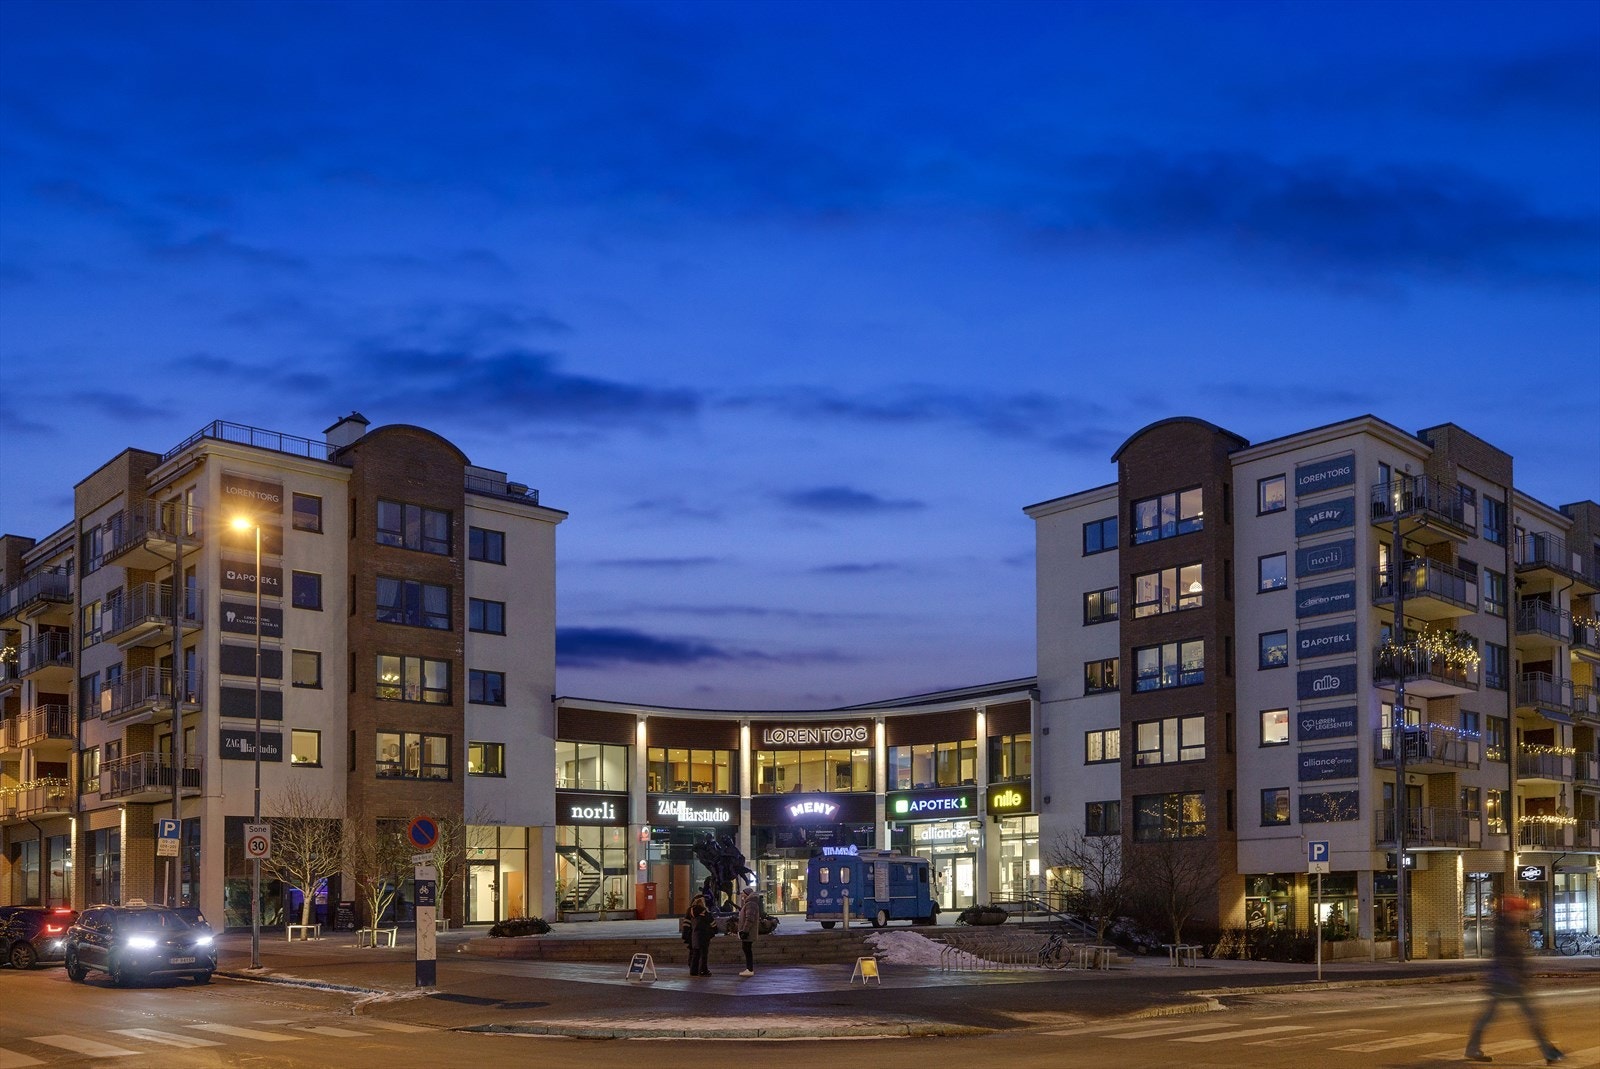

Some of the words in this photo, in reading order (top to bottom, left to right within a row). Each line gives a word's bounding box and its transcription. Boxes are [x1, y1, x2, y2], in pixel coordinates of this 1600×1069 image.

[1327, 466, 1350, 479] TORG
[256, 491, 279, 503] TORG
[1308, 510, 1341, 524] MENY
[1311, 552, 1338, 566] norli
[236, 573, 272, 585] APOEK
[1311, 635, 1344, 647] APOTEK
[1345, 633, 1350, 641] 1
[1313, 675, 1340, 691] nille
[764, 728, 819, 744] LØREN
[822, 726, 868, 742] TORG
[910, 798, 959, 812] APOTEK
[959, 797, 968, 808] 1
[993, 790, 1022, 807] nille
[571, 802, 616, 820] norli
[790, 801, 836, 816] MENY
[164, 821, 176, 837] P
[249, 825, 267, 833] Sone
[921, 827, 964, 840] alliance
[252, 840, 265, 851] 30
[1313, 844, 1325, 860] P
